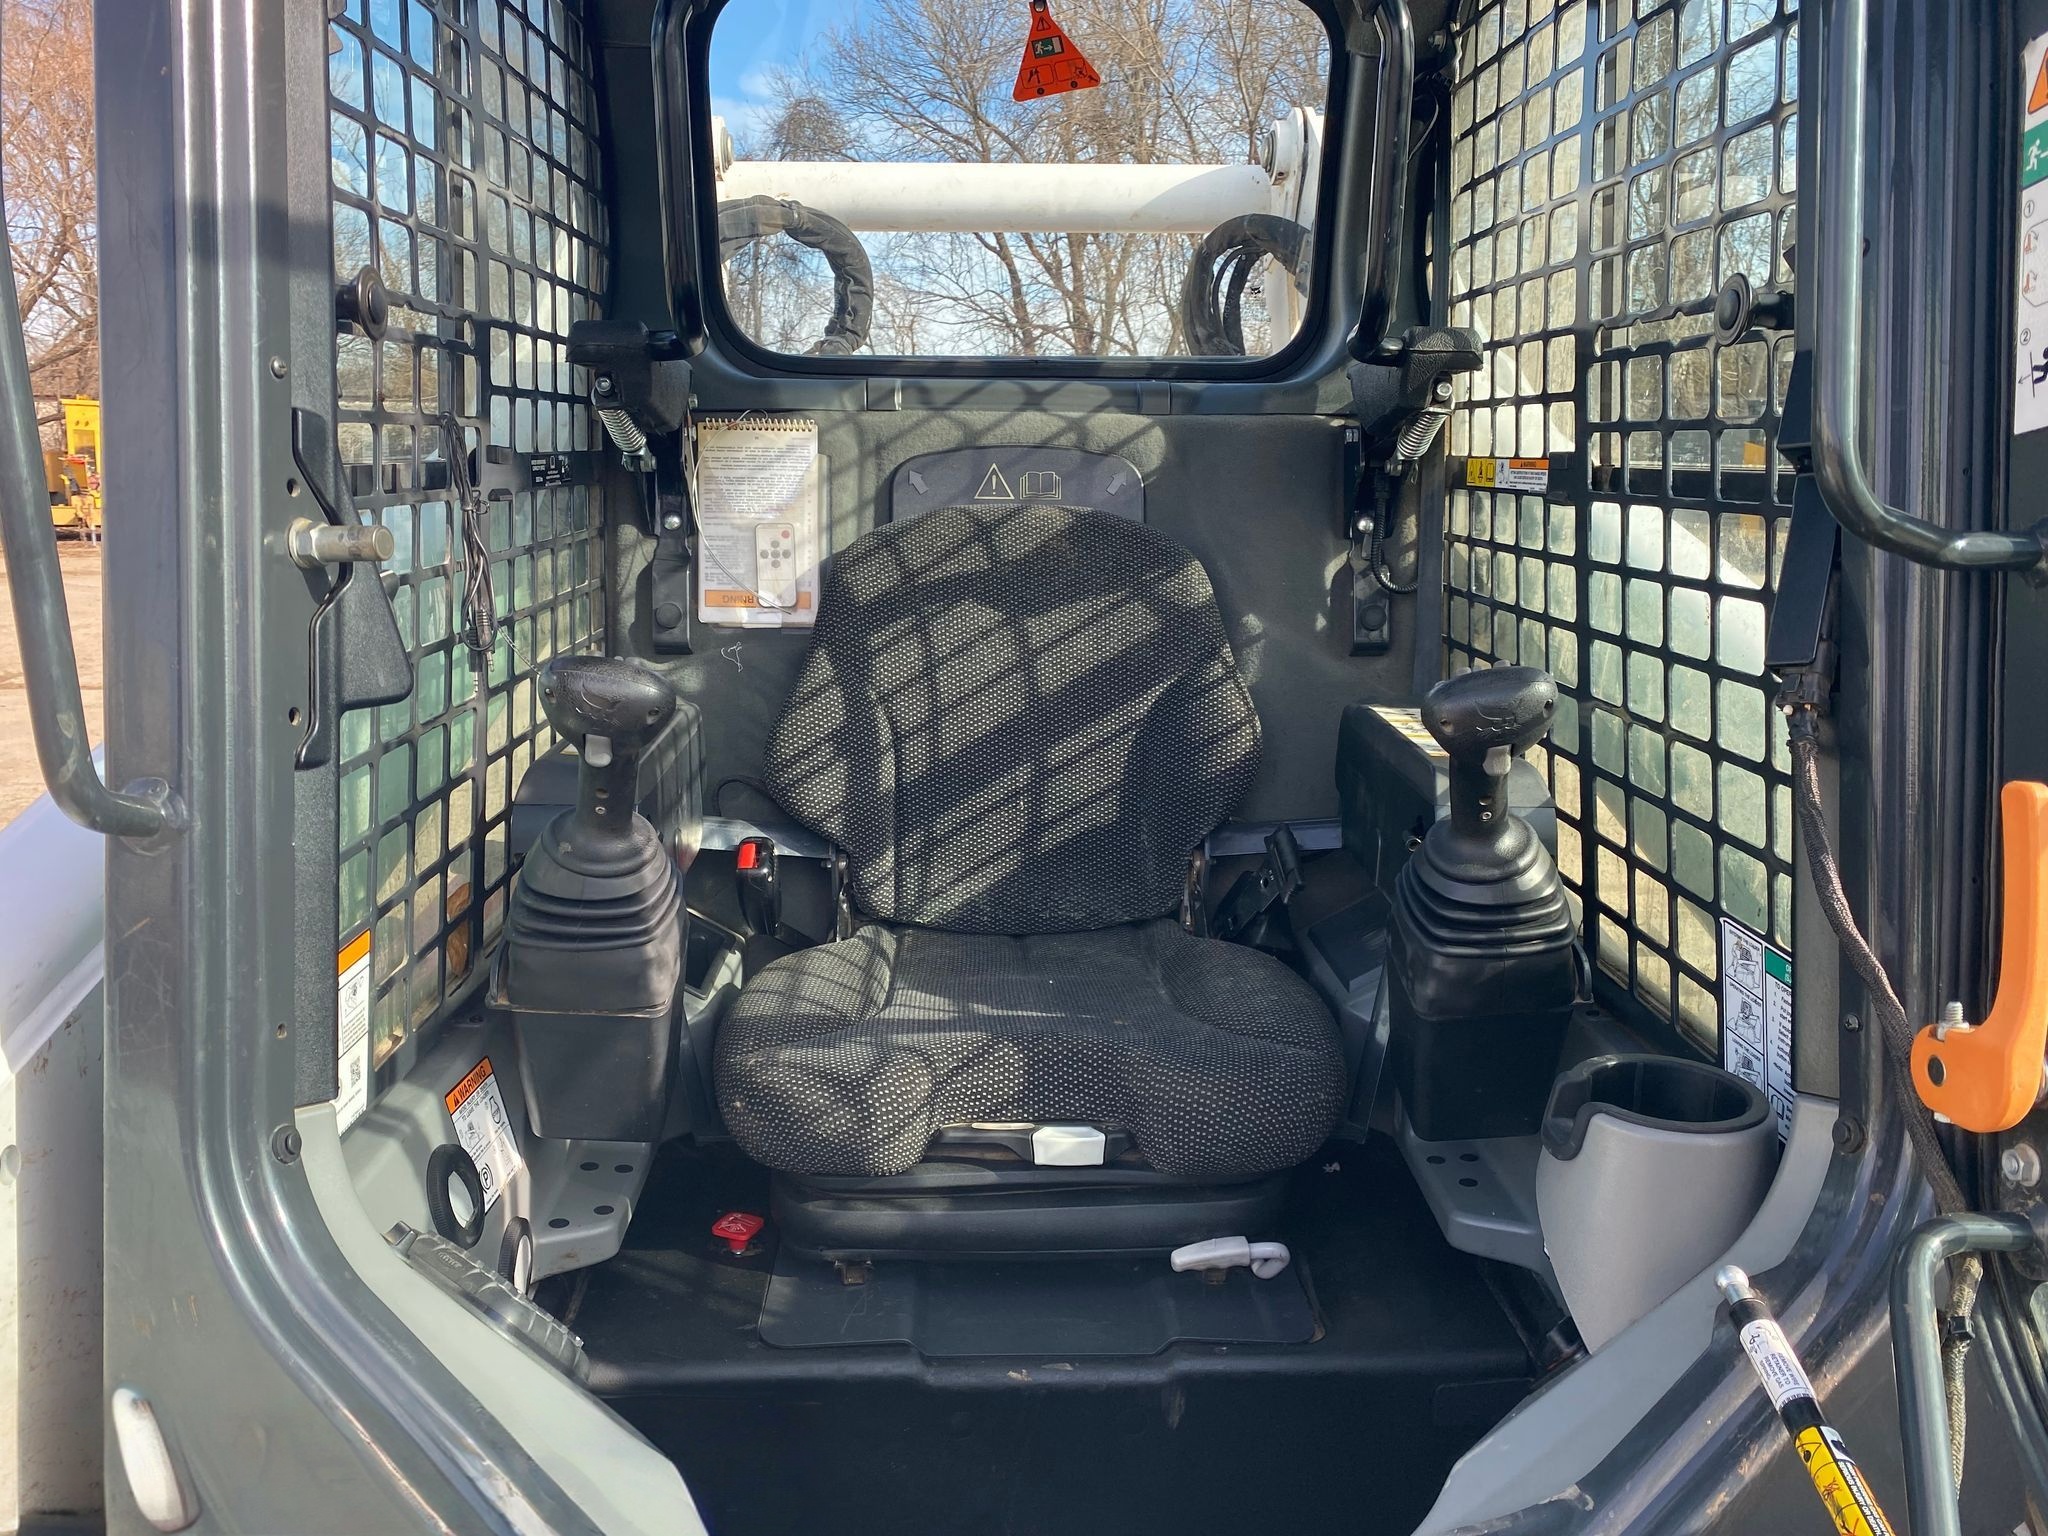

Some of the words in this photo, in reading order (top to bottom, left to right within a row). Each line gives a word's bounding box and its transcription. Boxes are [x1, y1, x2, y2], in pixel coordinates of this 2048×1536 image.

[722, 594, 754, 604] RNING
[457, 1065, 487, 1101] WARNING
[1764, 1355, 1779, 1378] REMOVE
[1775, 1376, 1785, 1389] GAS
[1770, 1353, 1787, 1377] RETAINER
[1778, 1352, 1792, 1372] REMOVE
[1789, 1373, 1800, 1386] WIRE
[1838, 1461, 1855, 1486] SERIOUS
[1850, 1485, 1867, 1506] INJURY
[1861, 1506, 1872, 1516] OR
